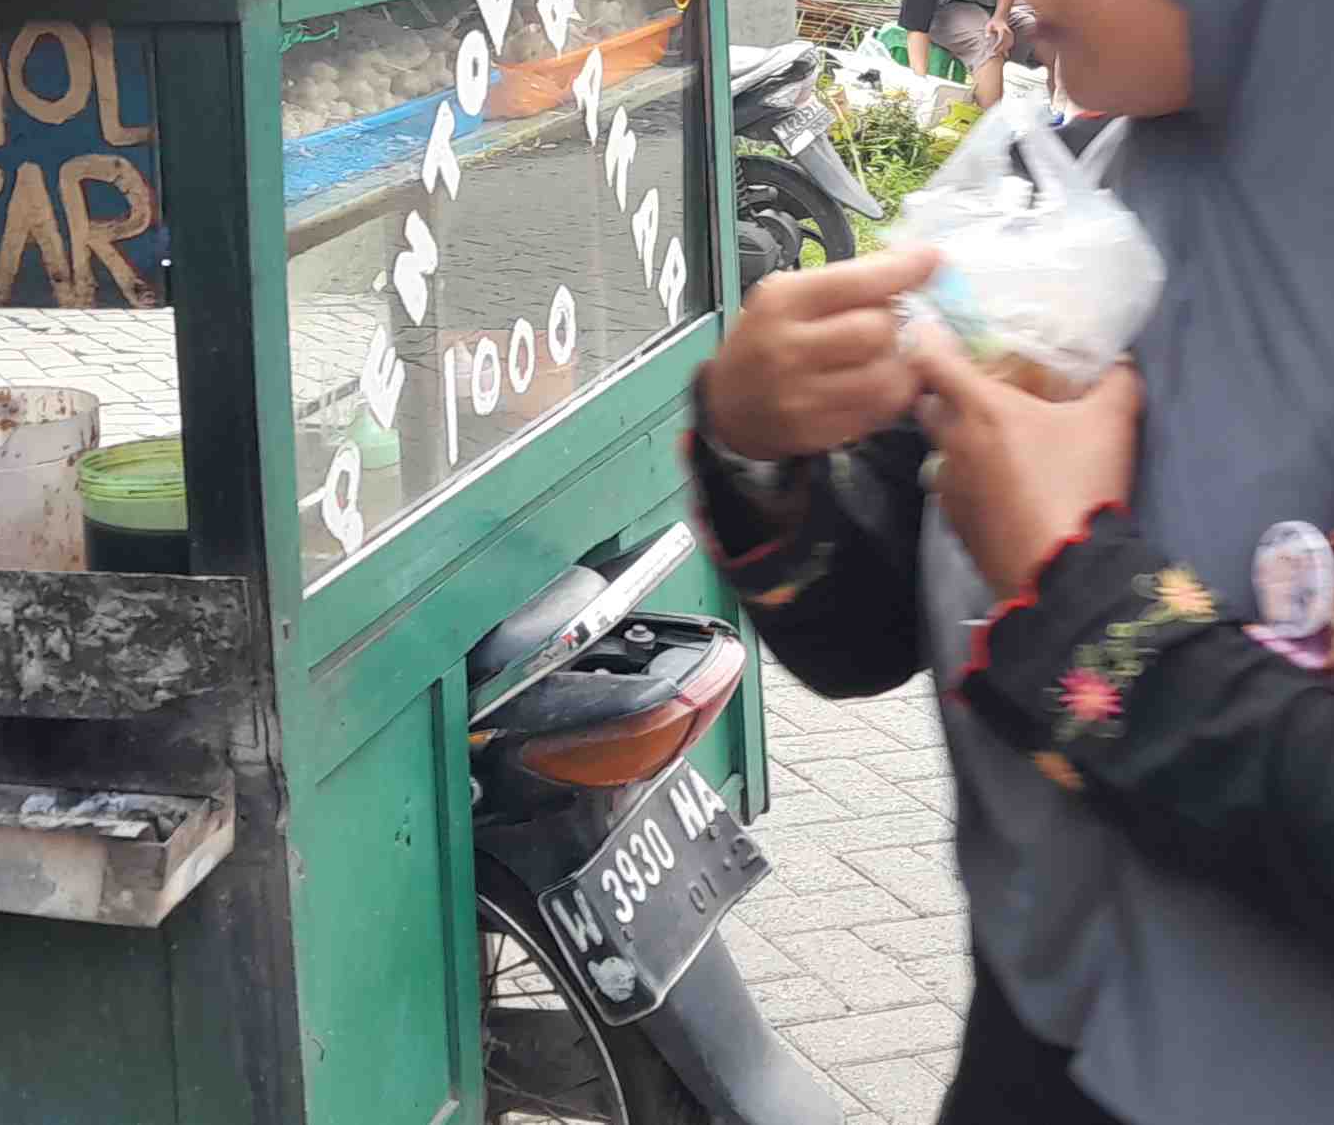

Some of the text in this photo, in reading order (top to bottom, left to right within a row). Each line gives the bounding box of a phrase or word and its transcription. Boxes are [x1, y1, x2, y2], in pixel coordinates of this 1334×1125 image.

[443, 283, 578, 467] 1000
[551, 889, 604, 953] W
[601, 818, 675, 923] 3930
